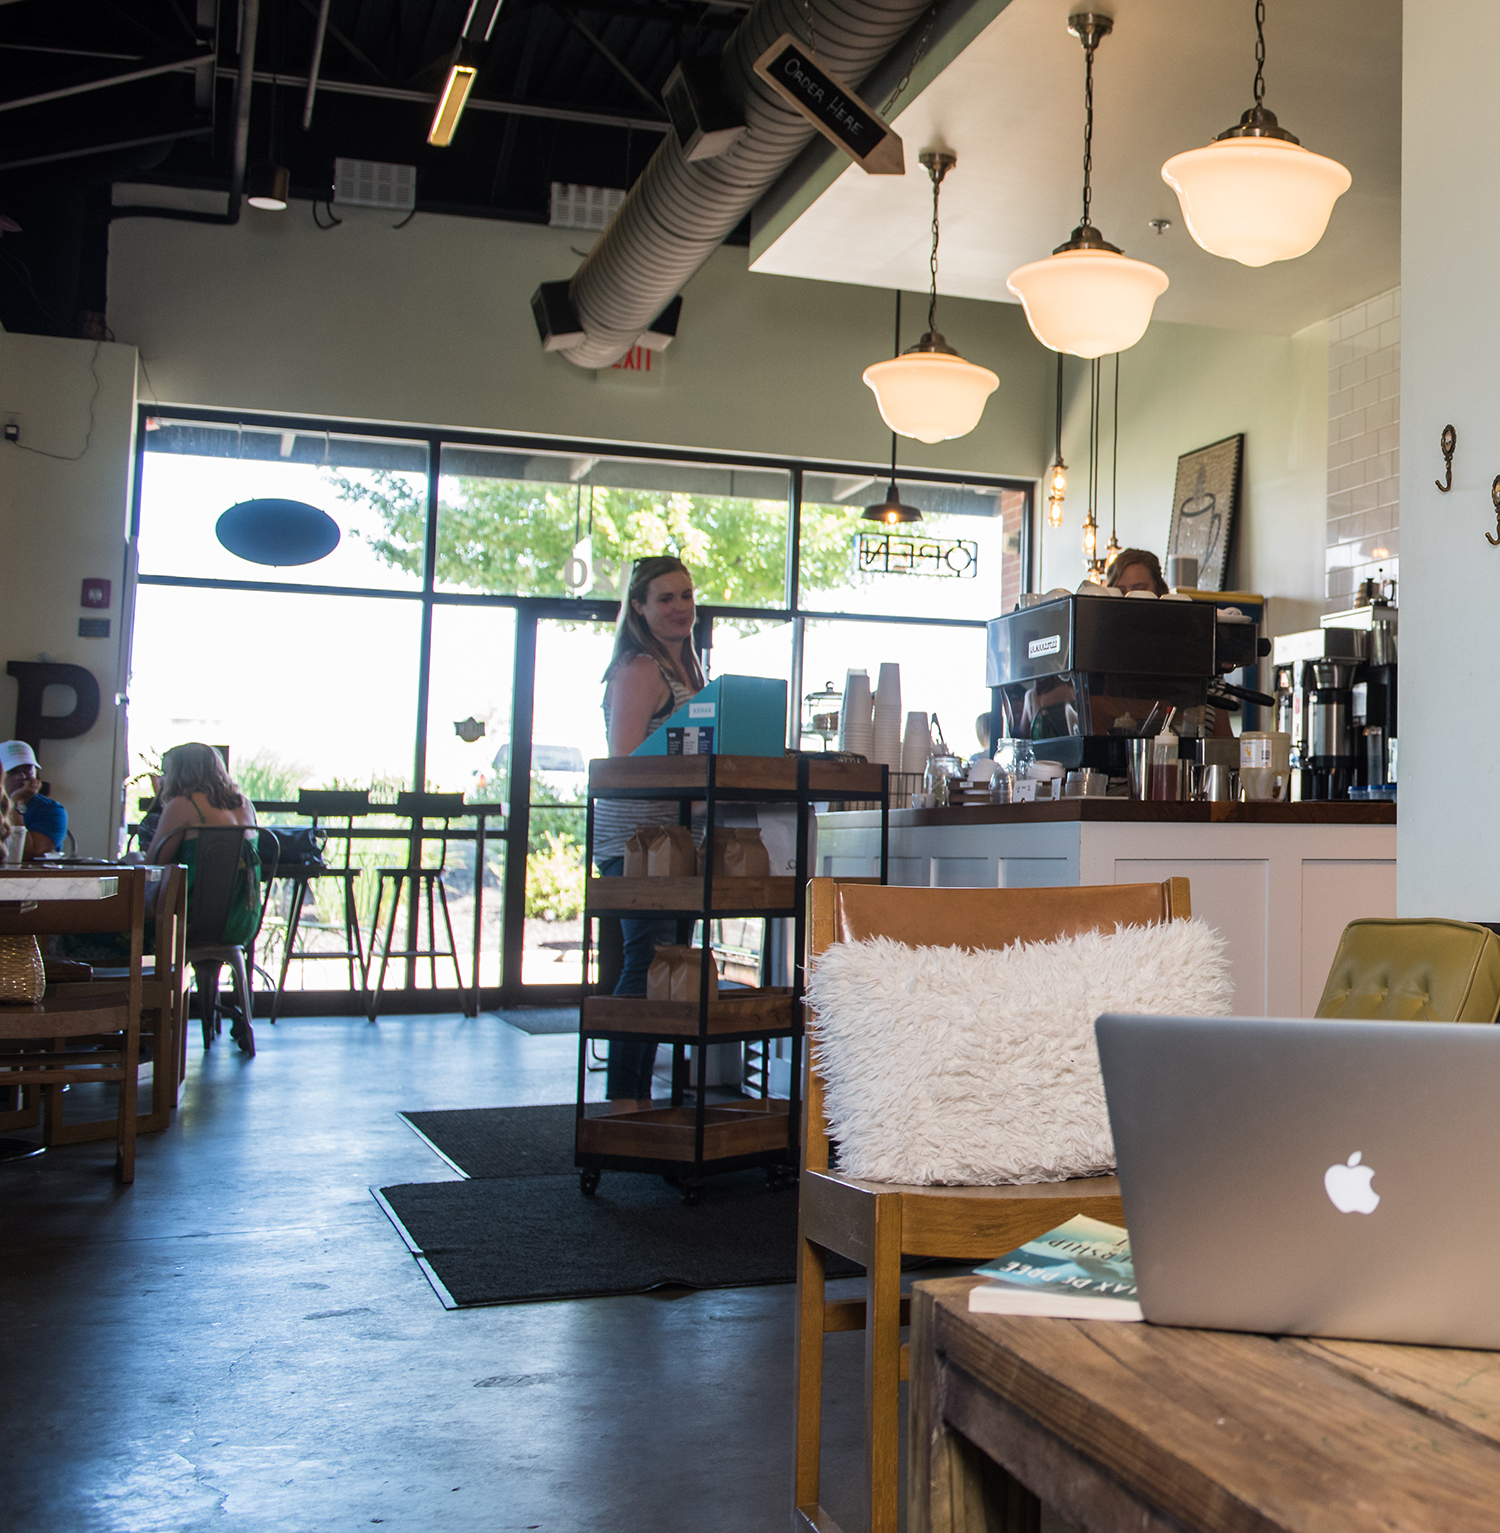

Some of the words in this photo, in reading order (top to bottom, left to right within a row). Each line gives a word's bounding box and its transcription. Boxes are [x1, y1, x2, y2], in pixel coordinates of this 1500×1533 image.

[784, 58, 825, 103] ORDER
[826, 96, 864, 135] HERE
[6, 660, 100, 796] P
